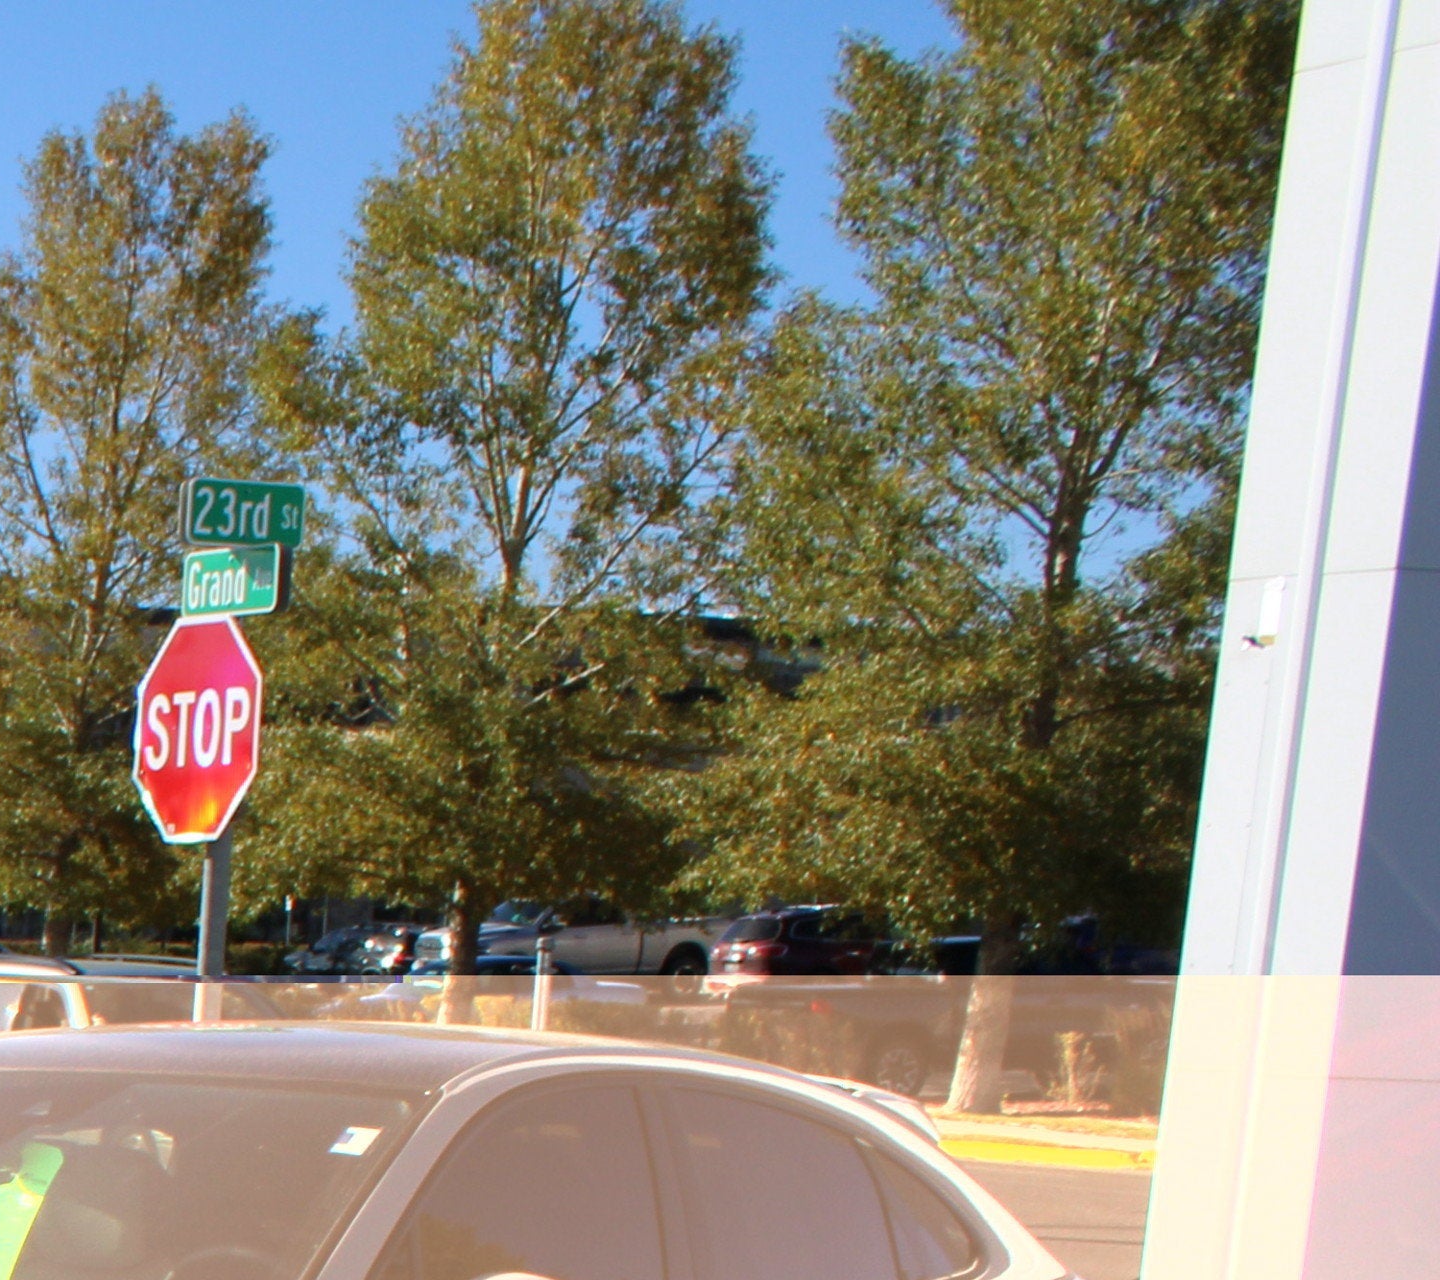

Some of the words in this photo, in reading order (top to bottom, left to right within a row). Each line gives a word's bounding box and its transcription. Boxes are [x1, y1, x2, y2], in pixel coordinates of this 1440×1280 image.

[193, 486, 271, 540] 23rd
[281, 503, 300, 530] St
[188, 559, 249, 611] Grand
[144, 686, 252, 771] STOP
